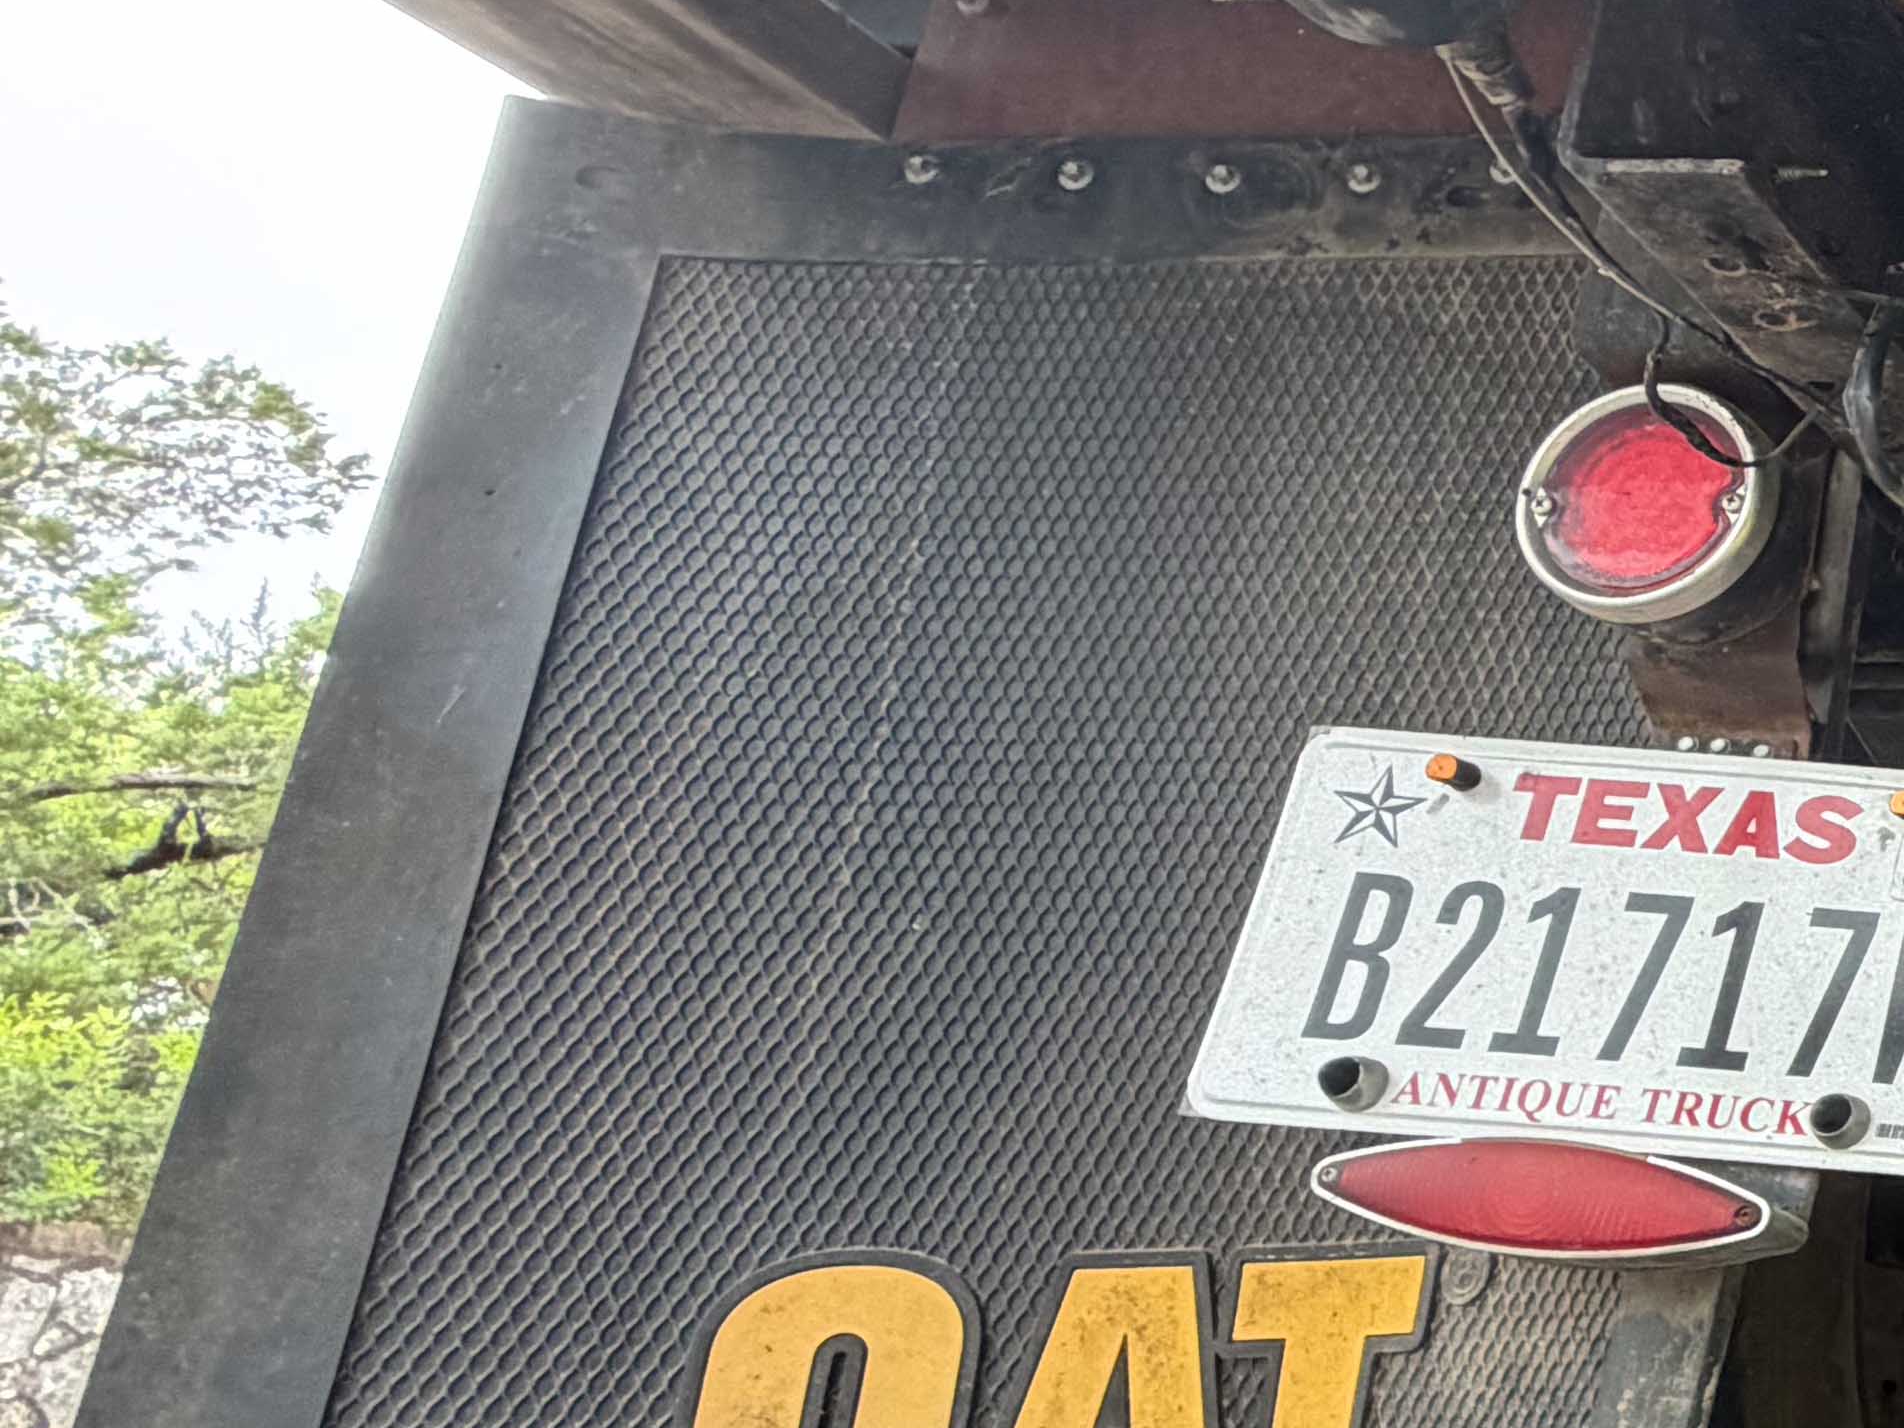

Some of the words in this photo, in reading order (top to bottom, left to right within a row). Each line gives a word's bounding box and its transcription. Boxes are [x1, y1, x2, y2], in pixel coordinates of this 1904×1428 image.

[1513, 772, 1866, 865] TEXAS
[1390, 1071, 1622, 1122] ANTIQUE
[1640, 1087, 1814, 1138] TRUCK
